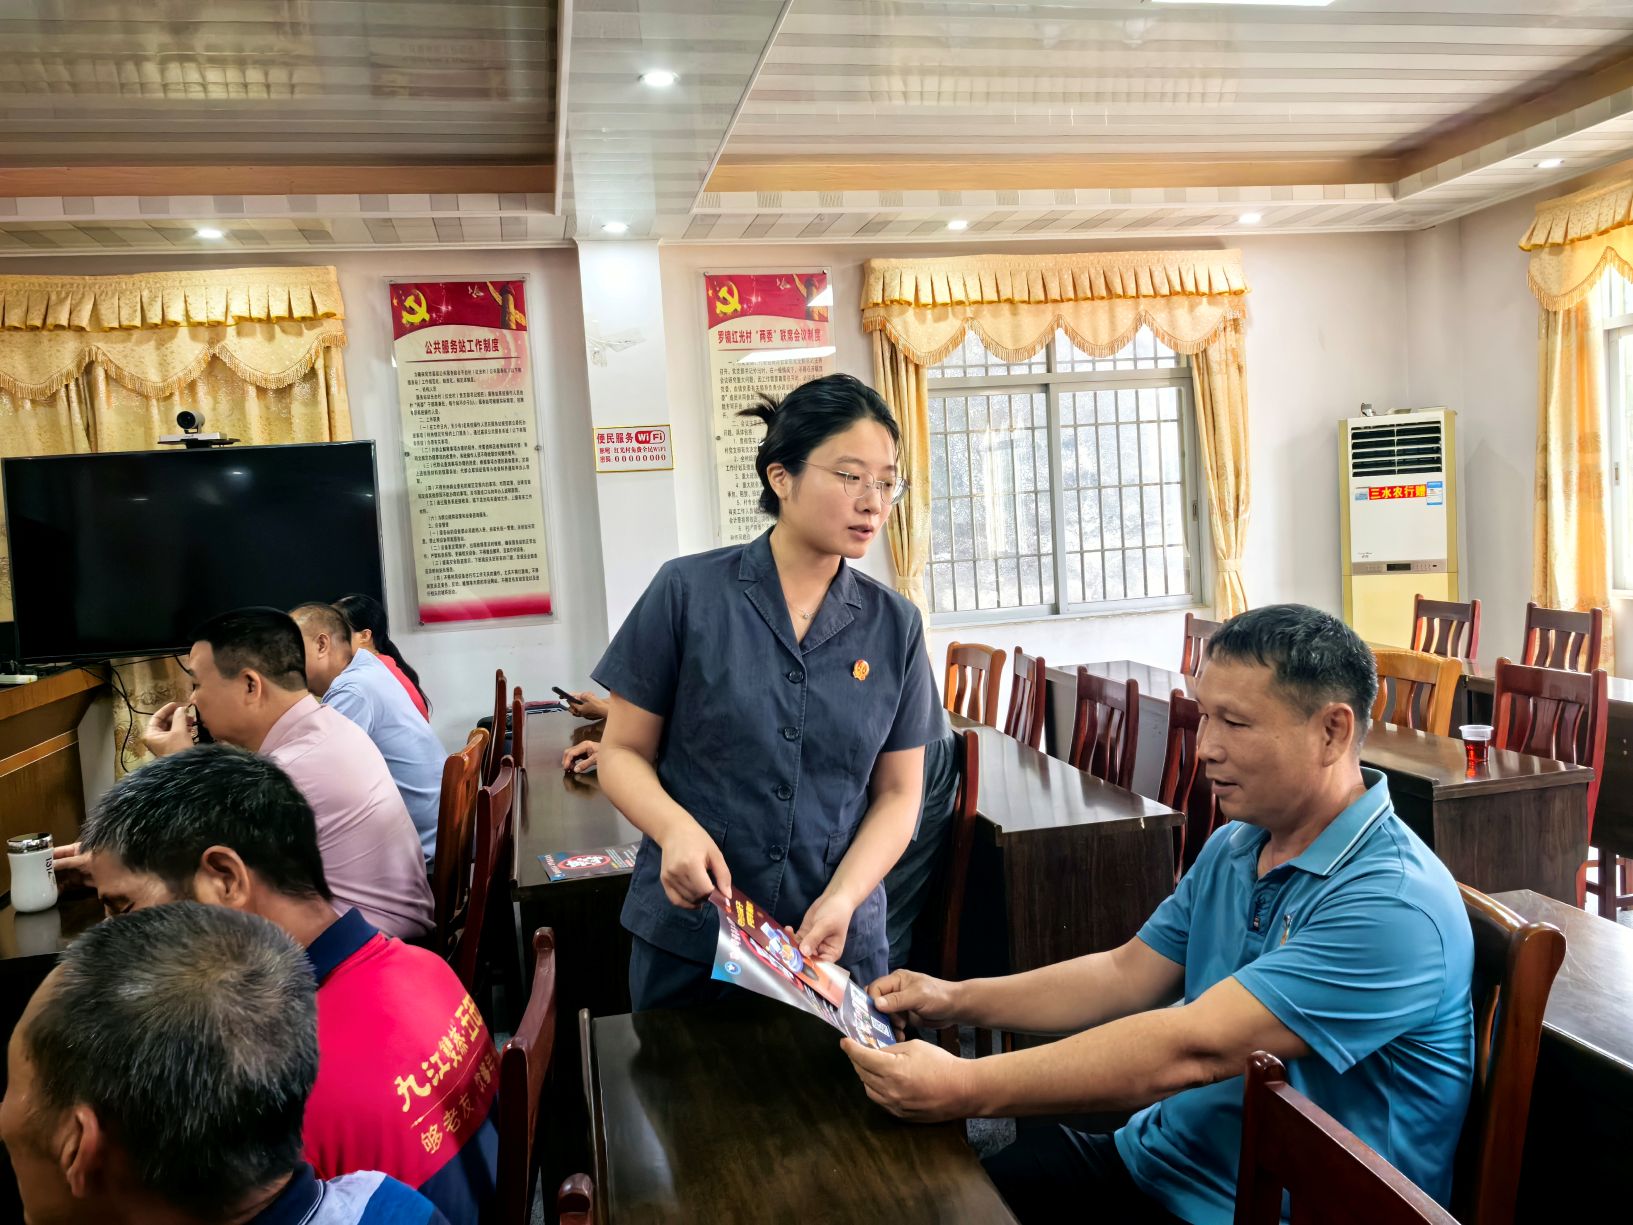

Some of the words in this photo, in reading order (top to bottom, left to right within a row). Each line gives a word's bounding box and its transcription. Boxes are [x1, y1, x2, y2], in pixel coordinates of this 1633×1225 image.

[425, 338, 500, 355] 公共服务站工作制度
[597, 432, 634, 444] 便民服务
